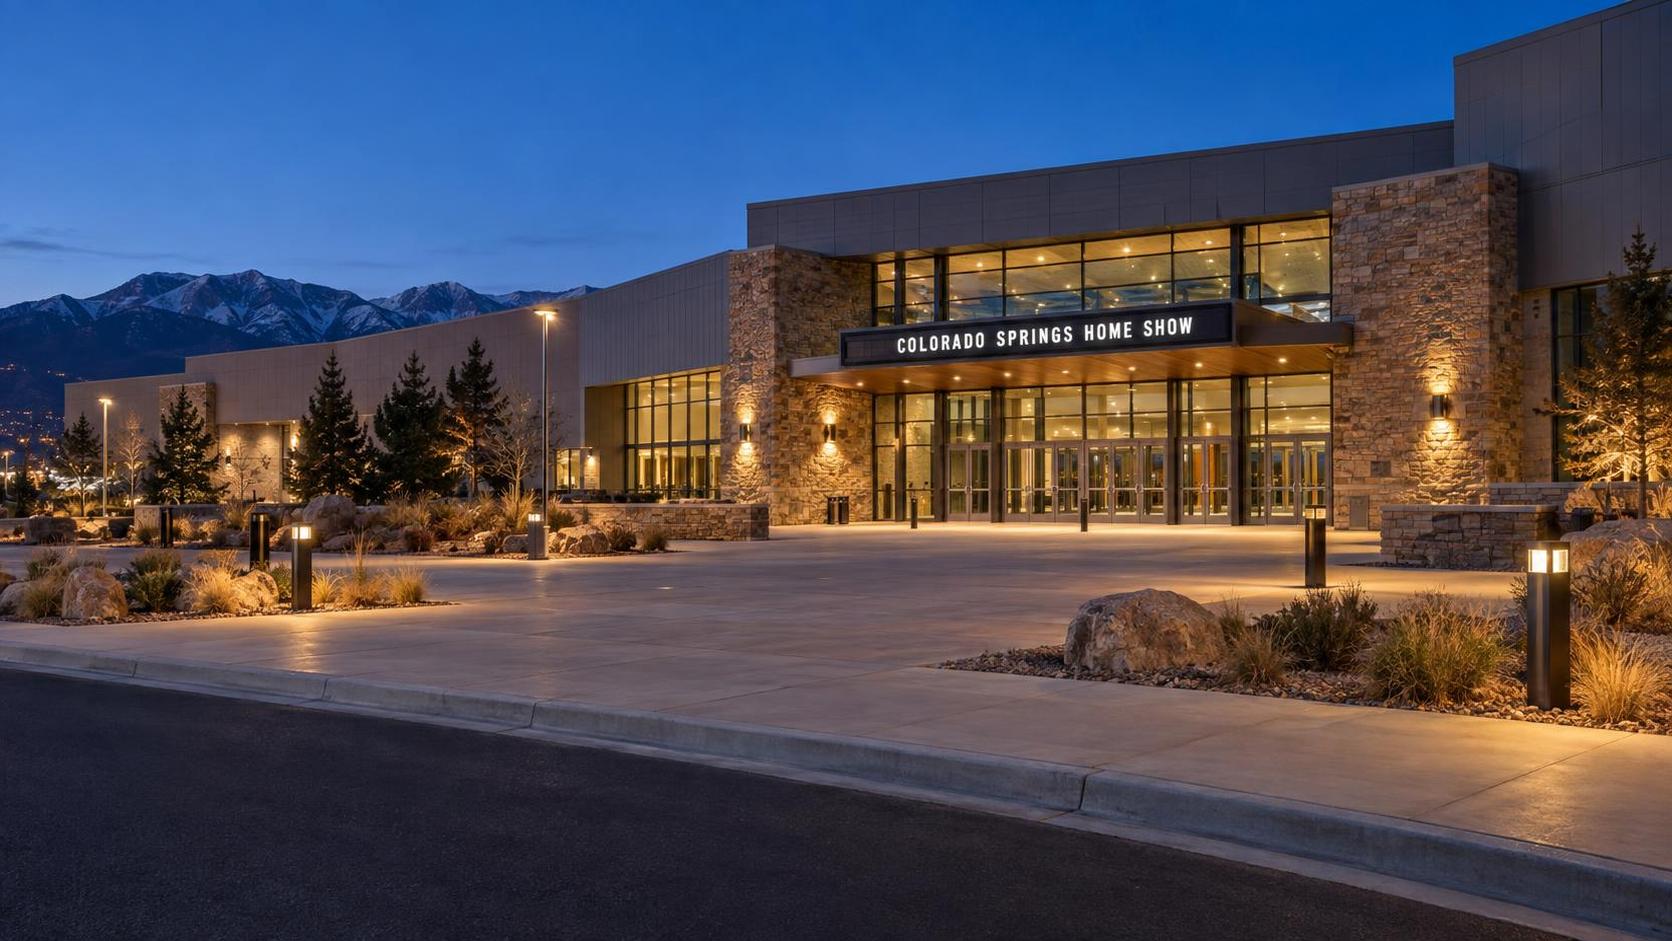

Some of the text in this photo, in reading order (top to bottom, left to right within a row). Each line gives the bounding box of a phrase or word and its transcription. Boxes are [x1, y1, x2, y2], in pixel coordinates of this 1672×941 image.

[896, 316, 1193, 354] COLORADO SPRINGS HOME SHOW
